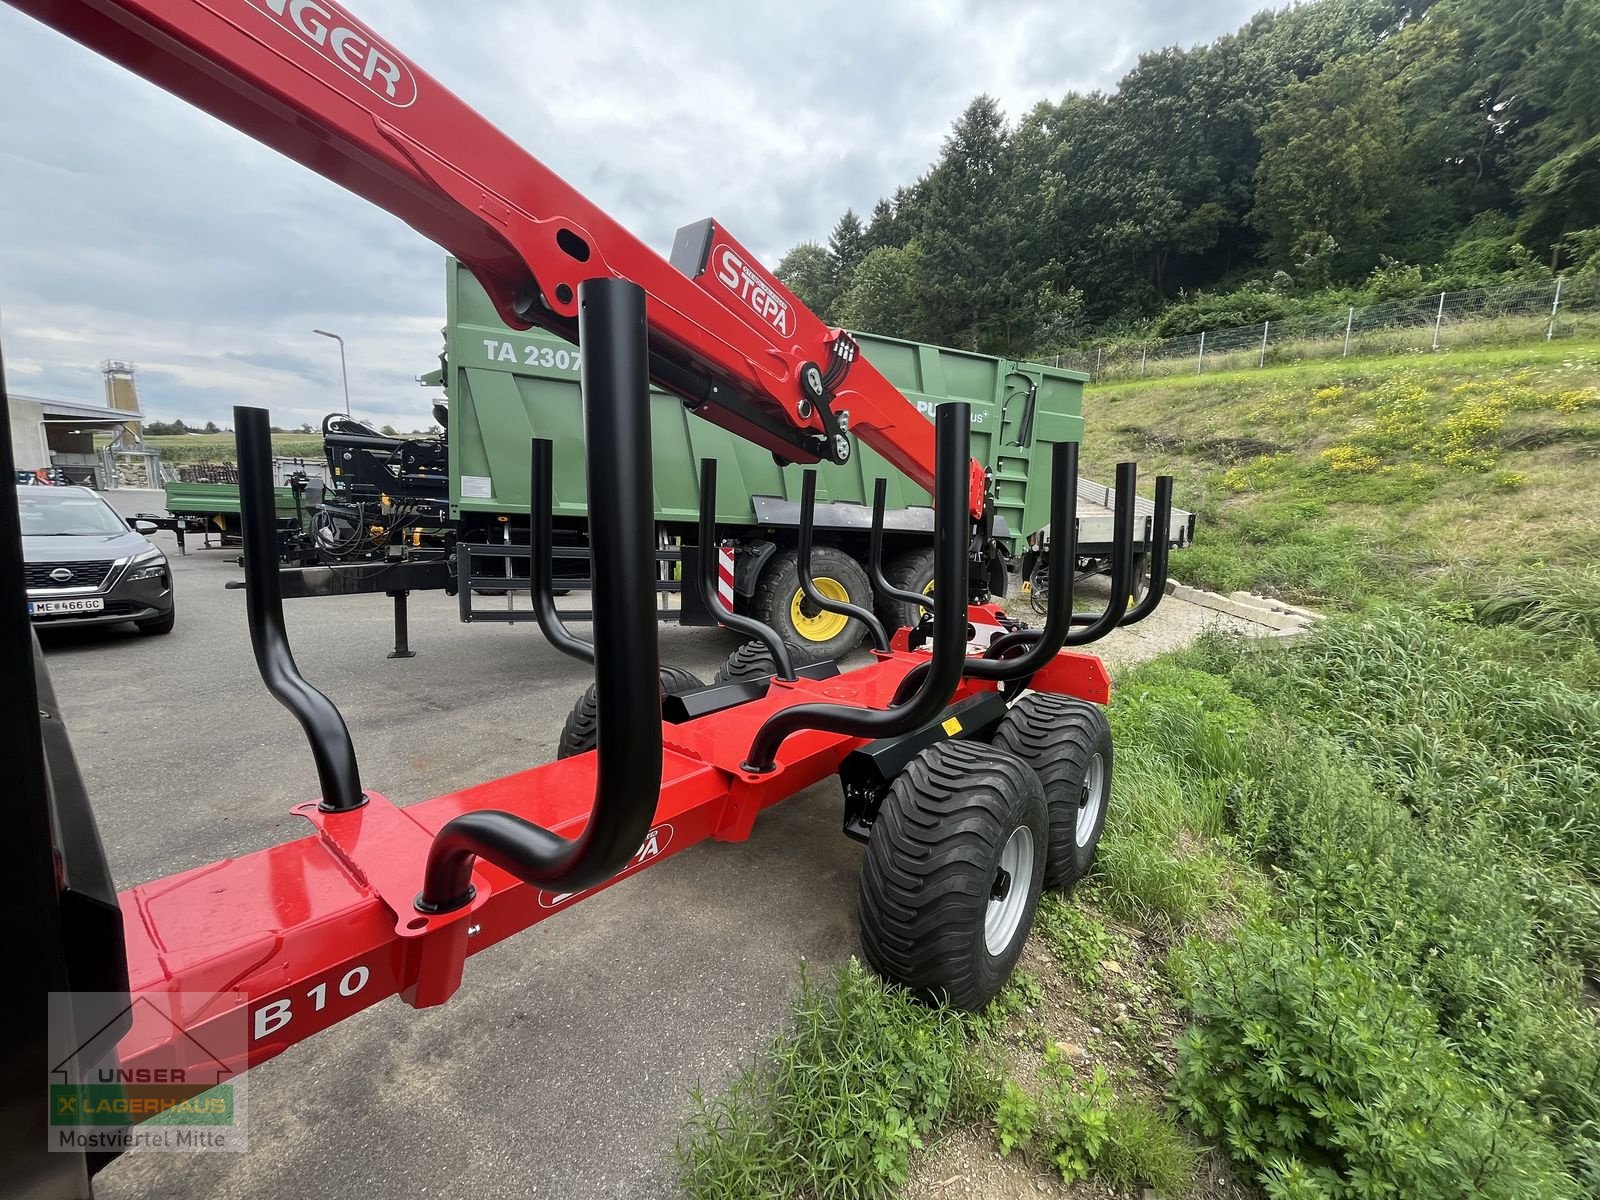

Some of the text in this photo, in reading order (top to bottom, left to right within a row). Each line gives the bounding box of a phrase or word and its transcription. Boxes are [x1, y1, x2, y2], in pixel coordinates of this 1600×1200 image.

[265, 0, 401, 98] GER
[719, 250, 787, 335] STEPA
[483, 339, 518, 363] TA
[37, 600, 100, 612] ME 466 GC
[254, 965, 370, 1041] B 10
